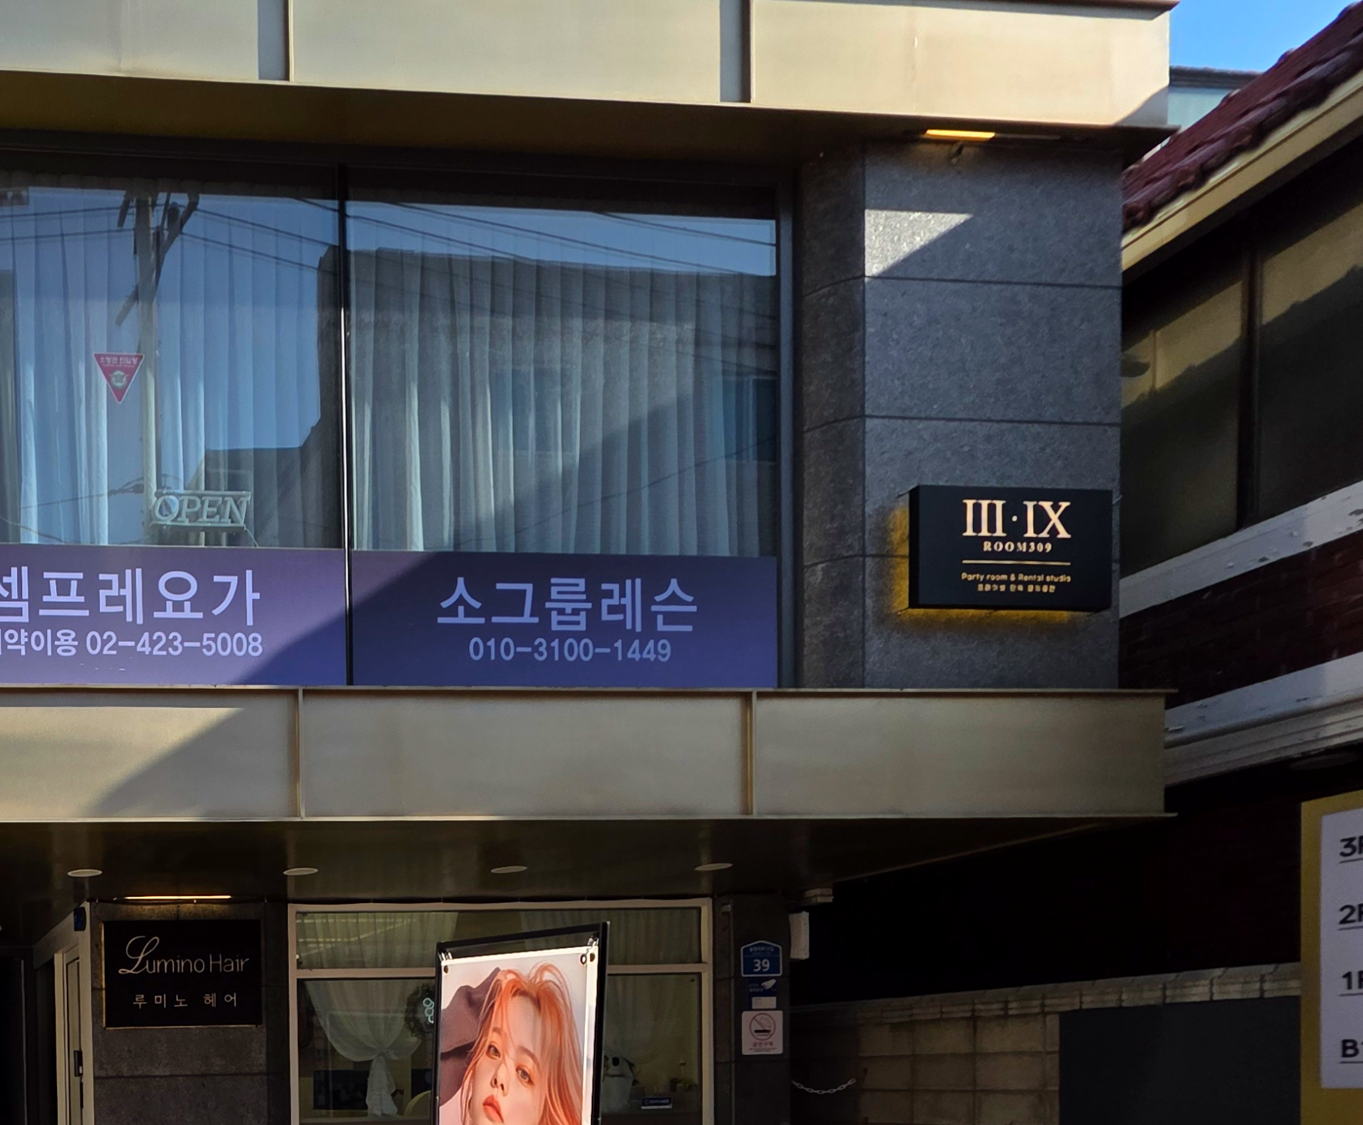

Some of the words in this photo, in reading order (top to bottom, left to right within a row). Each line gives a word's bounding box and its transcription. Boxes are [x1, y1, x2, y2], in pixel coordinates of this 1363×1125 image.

[154, 494, 250, 525] OPEN
[983, 541, 1052, 553] ROOM309
[961, 572, 984, 582] Party
[986, 573, 1008, 581] room
[1018, 573, 1044, 582] Rental
[1046, 574, 1072, 583] studio
[437, 576, 698, 632] 소그룹레슨
[86, 631, 264, 657] 02-423-5008
[469, 636, 672, 662] 010-3100-1449
[118, 935, 206, 975] Lumino
[209, 953, 250, 973] Hair
[752, 958, 771, 972] 39
[132, 993, 188, 1009] 루미노
[203, 992, 237, 1008] 헤어
[1341, 1039, 1363, 1058] B
